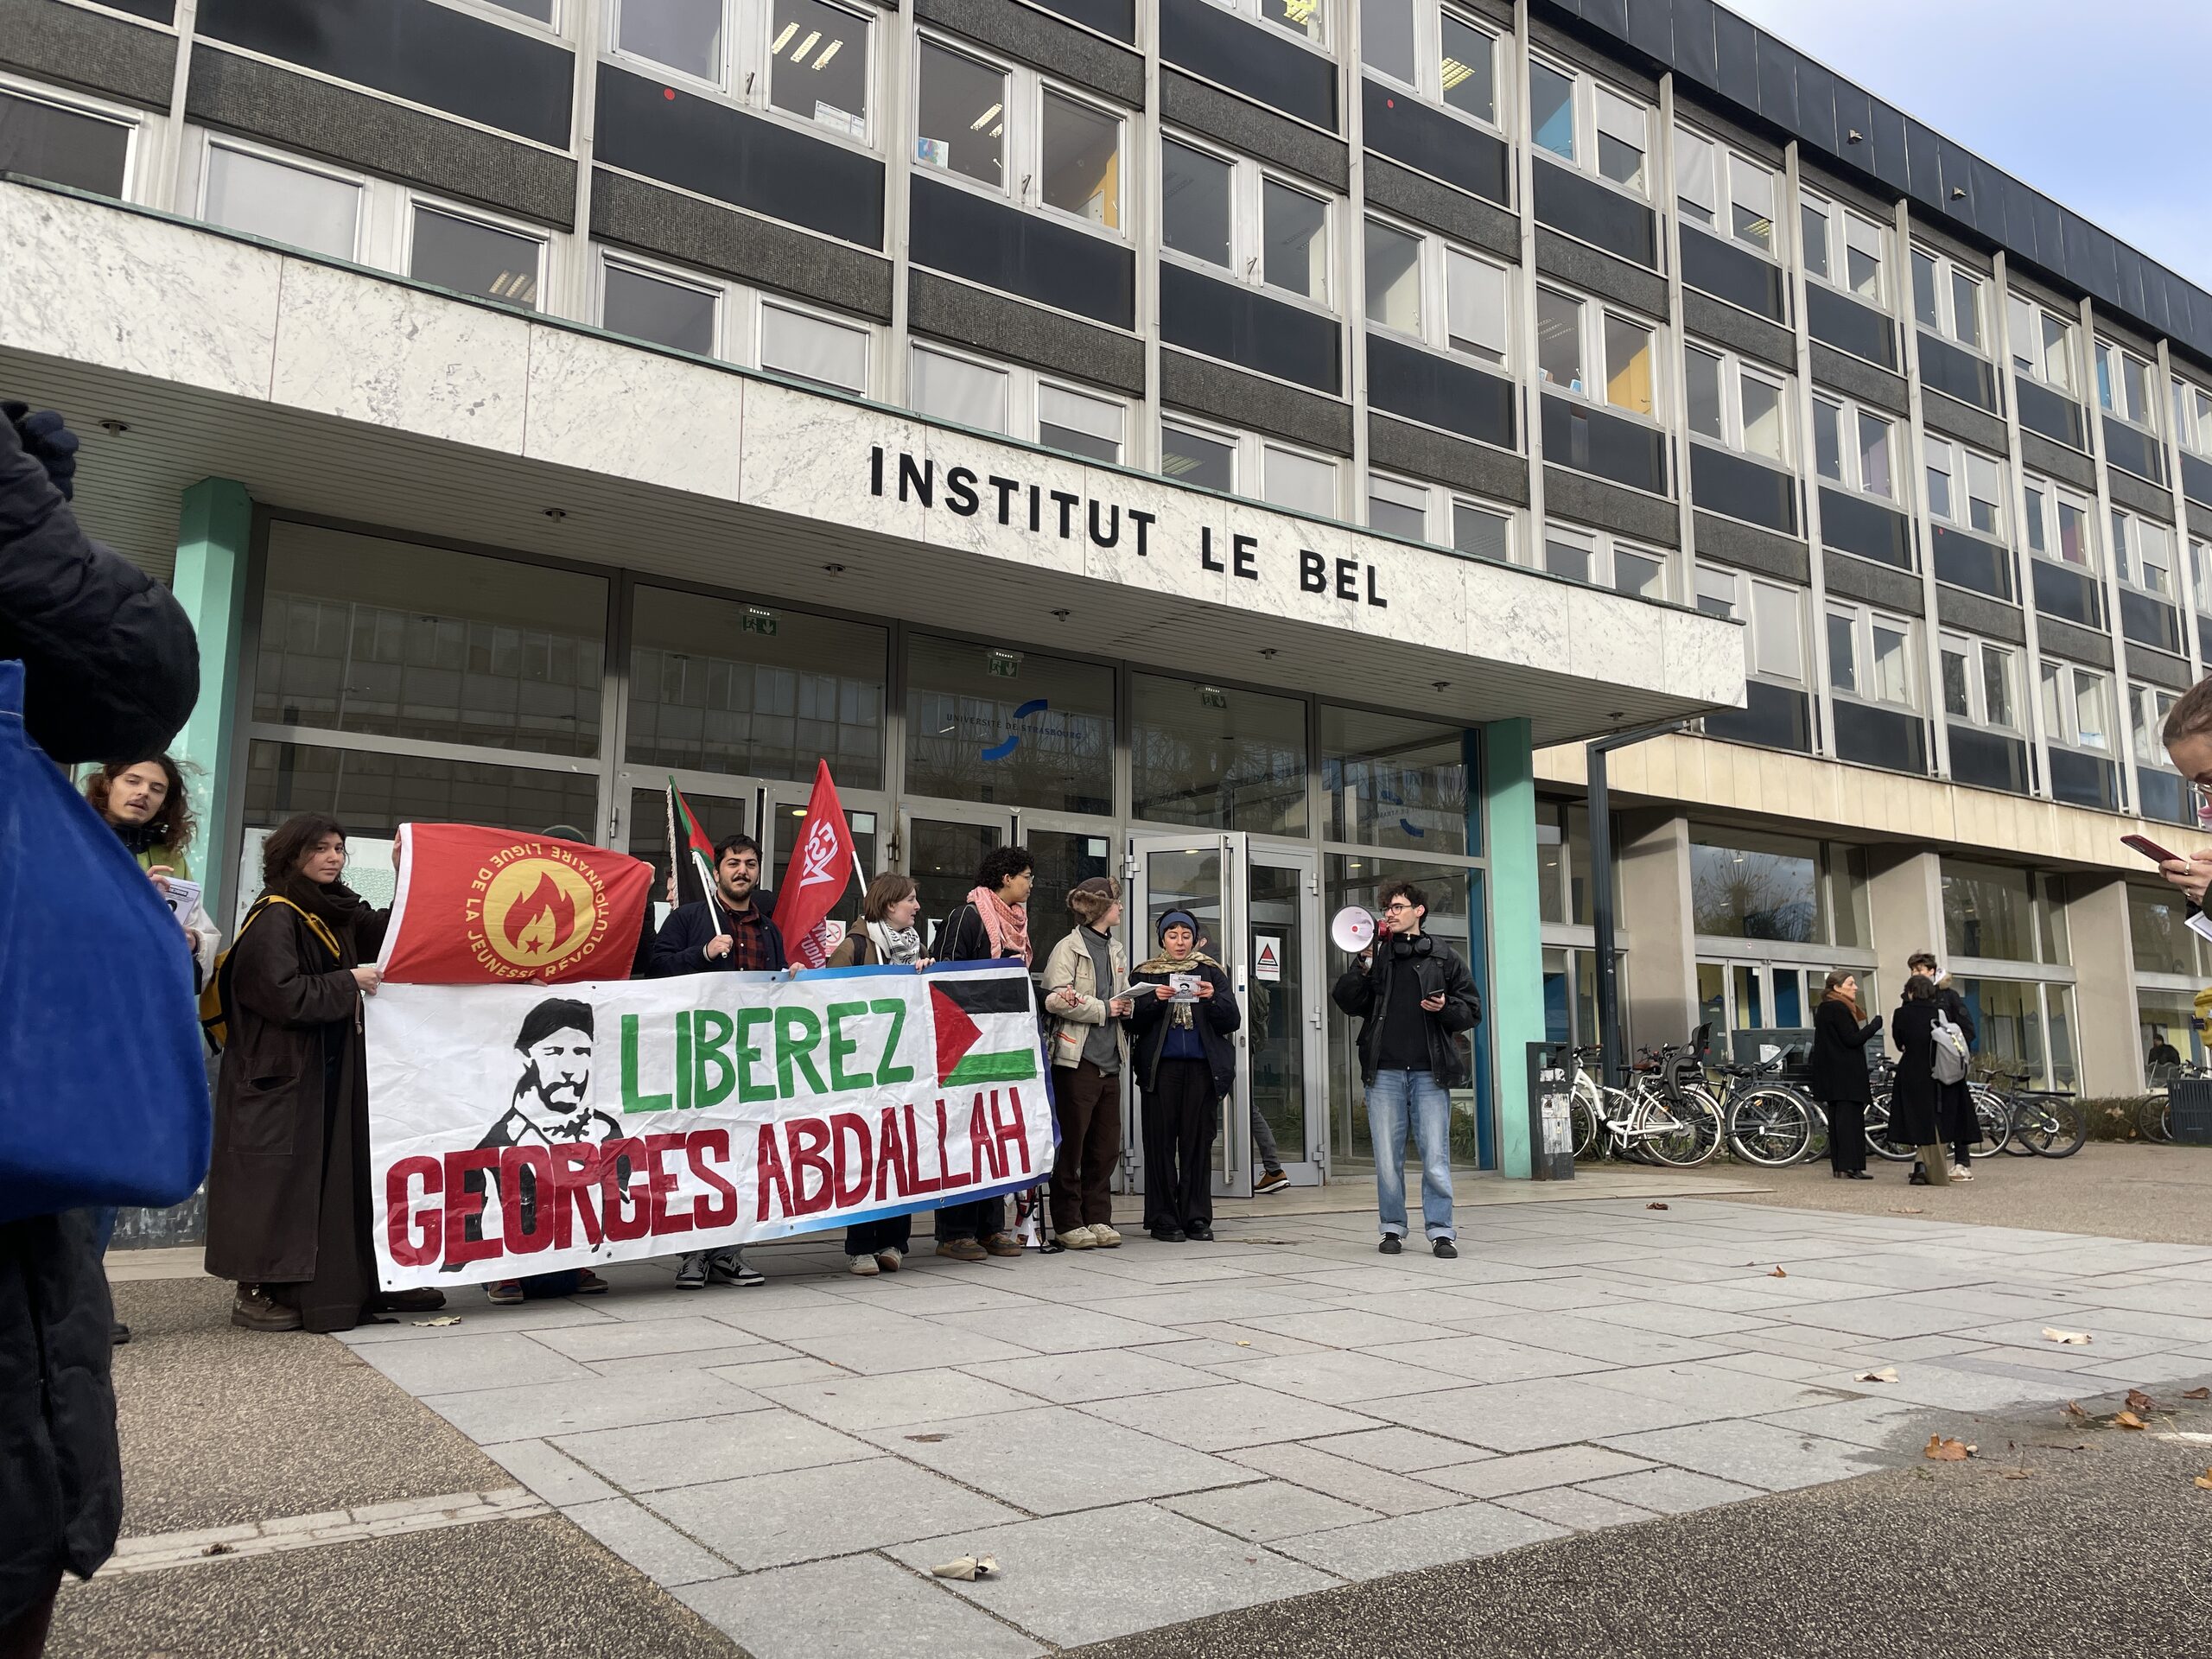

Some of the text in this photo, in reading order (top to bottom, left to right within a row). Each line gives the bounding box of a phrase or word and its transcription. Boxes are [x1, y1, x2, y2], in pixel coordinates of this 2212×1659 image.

[871, 446, 1388, 608] INSTITUT LE BEL
[1005, 722, 1019, 731] DE
[489, 842, 542, 868] LIGUE
[471, 868, 493, 892] DE
[465, 898, 481, 922] LA
[621, 997, 914, 1115] LIBEREZ
[386, 1086, 1031, 1268] GEORGES ABDALLAH
